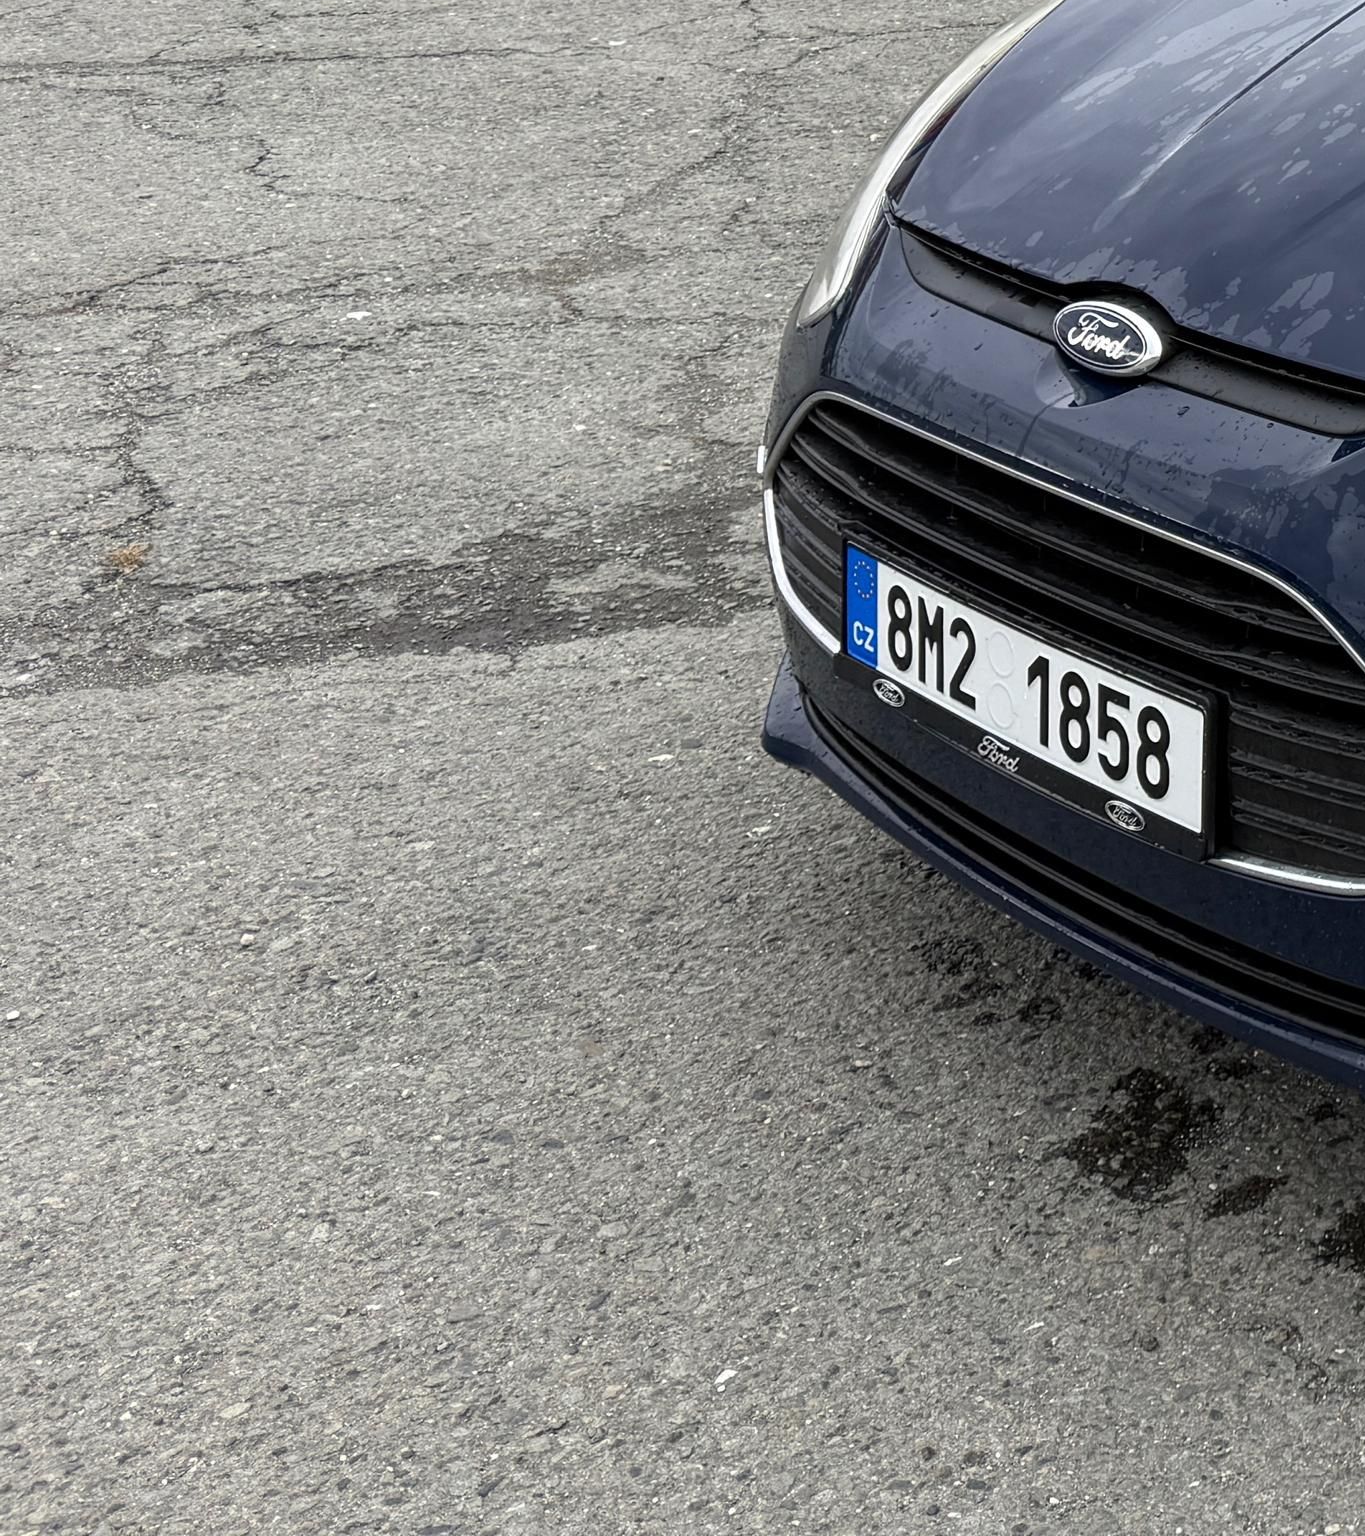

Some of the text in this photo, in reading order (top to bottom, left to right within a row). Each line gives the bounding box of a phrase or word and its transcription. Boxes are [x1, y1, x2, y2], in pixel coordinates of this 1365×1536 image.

[1067, 311, 1131, 360] Ford
[853, 619, 875, 653] CZ
[887, 584, 1171, 800] 8M2 1858
[977, 735, 1020, 773] Ford
[1112, 805, 1138, 827] Ford
